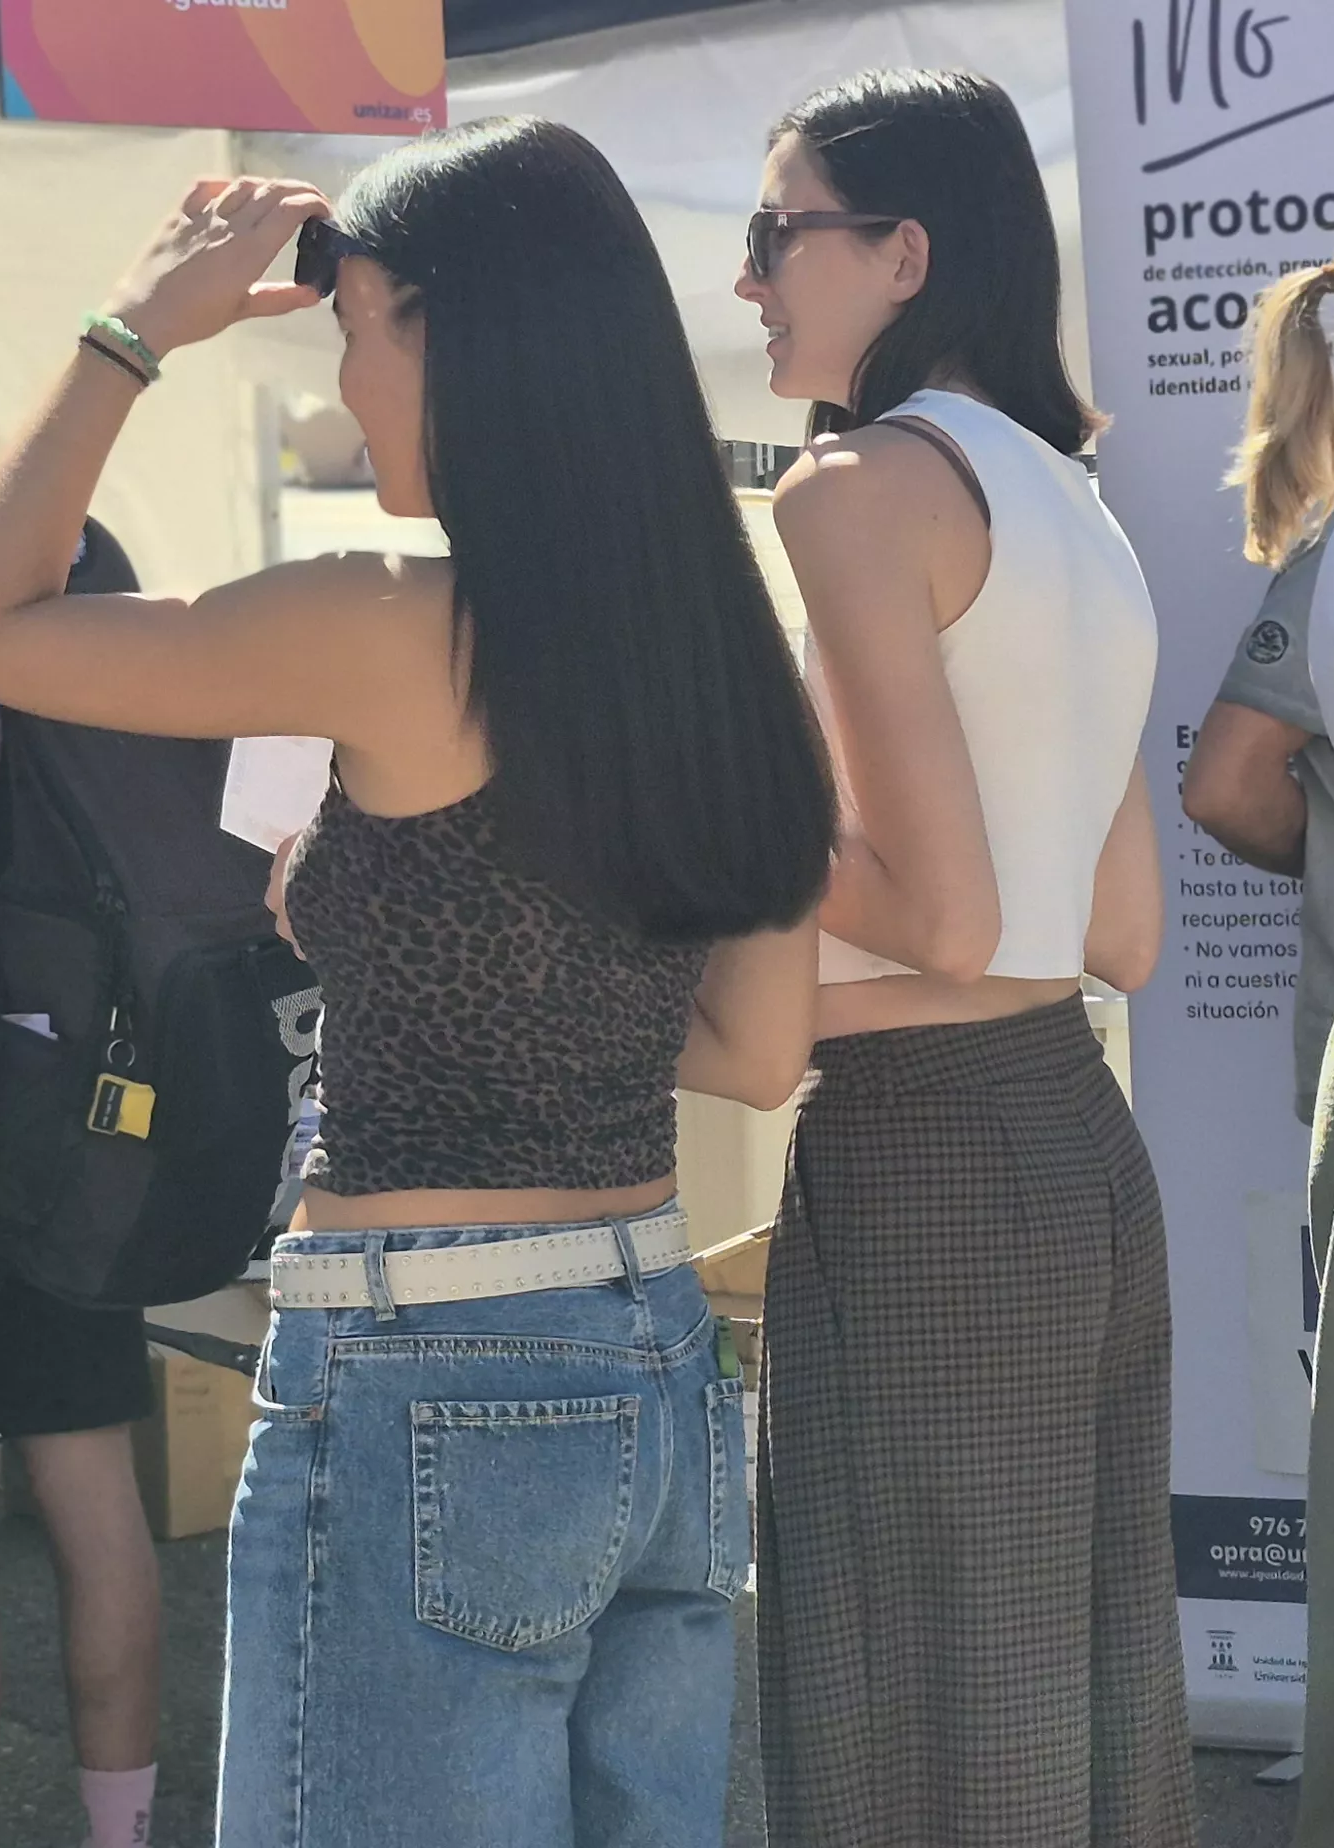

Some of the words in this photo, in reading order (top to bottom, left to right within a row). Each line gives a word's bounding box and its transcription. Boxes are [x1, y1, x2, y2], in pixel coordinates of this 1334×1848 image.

[352, 101, 433, 123] unizar.es
[1143, 264, 1166, 282] de
[1171, 256, 1274, 282] detección,
[1146, 291, 1264, 334] aco
[1147, 348, 1215, 369] sexual,
[1220, 349, 1251, 370] po
[1148, 374, 1242, 397] identidad
[1180, 879, 1237, 898] hasta
[1243, 878, 1264, 897] tu
[1269, 879, 1304, 897] tot
[1195, 942, 1223, 958] No
[1228, 942, 1298, 958] vamos
[1185, 972, 1203, 989] ni
[1207, 975, 1220, 989] a
[1186, 1001, 1280, 1020] situación
[1249, 1515, 1291, 1537] 976
